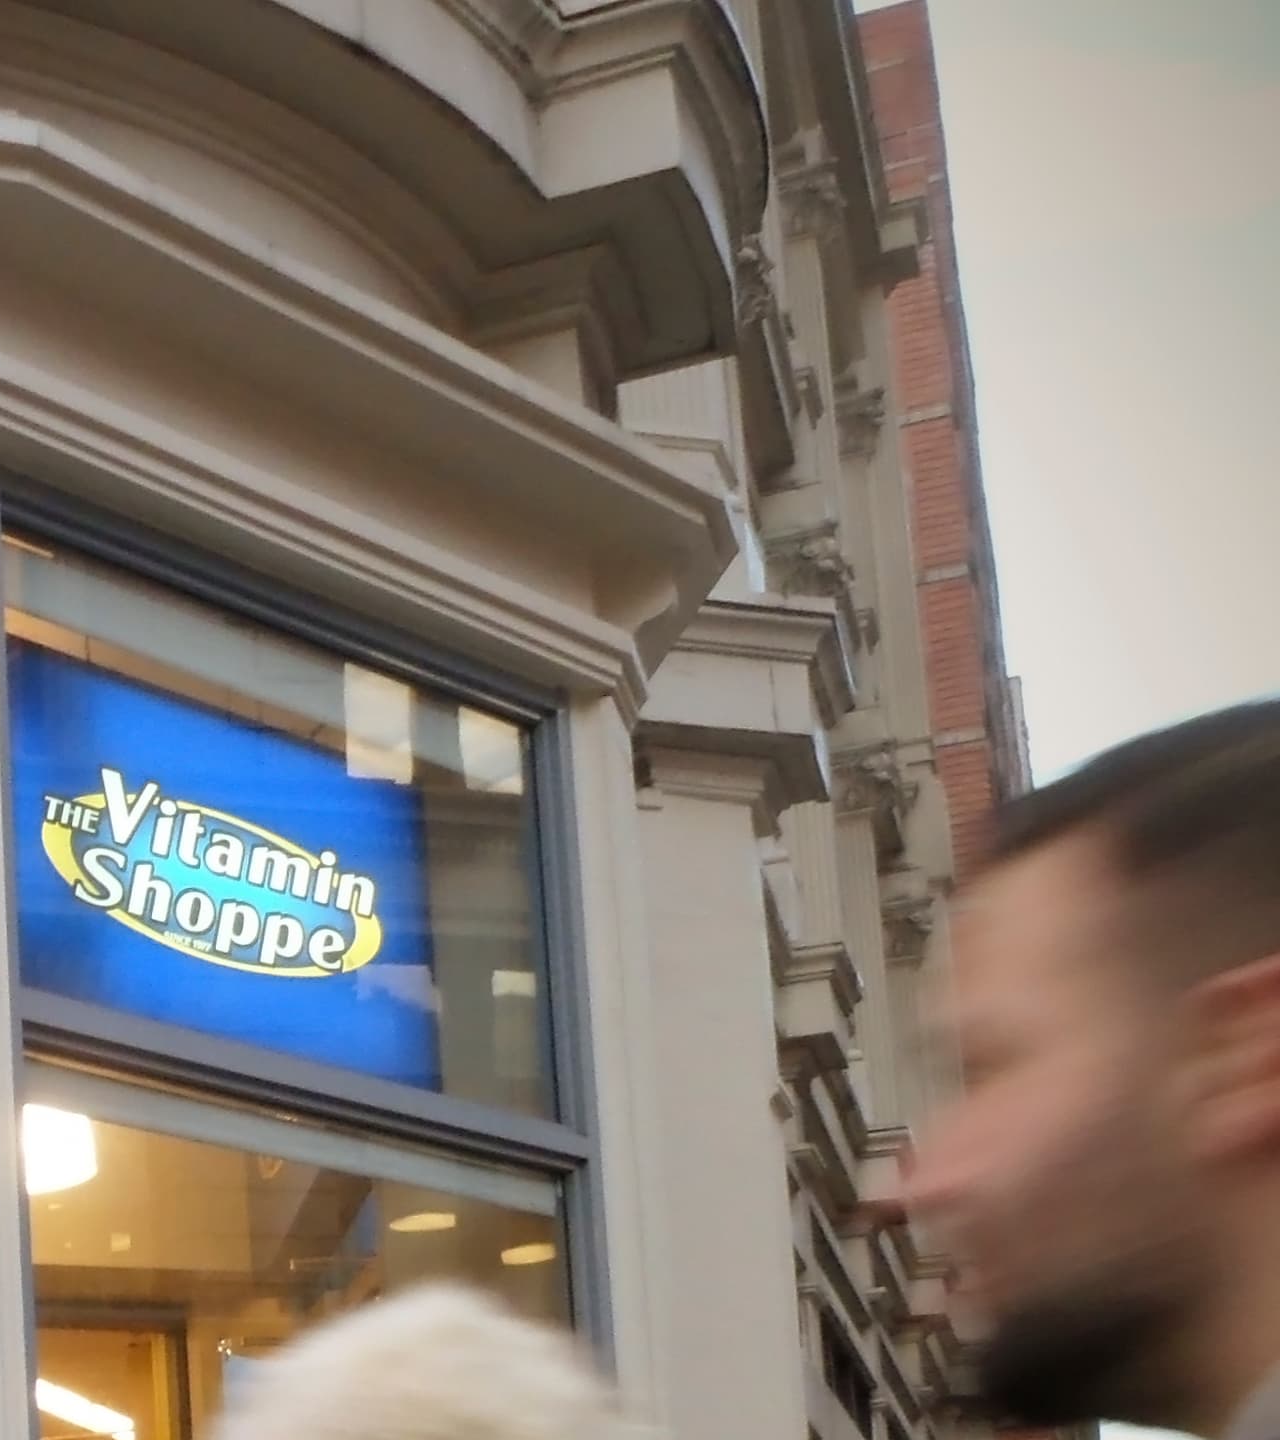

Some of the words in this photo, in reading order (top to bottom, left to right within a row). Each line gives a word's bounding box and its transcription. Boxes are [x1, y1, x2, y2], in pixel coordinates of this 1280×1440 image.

[44, 795, 101, 834] THE
[100, 767, 376, 917] Vitamin
[74, 848, 346, 970] Shoppe
